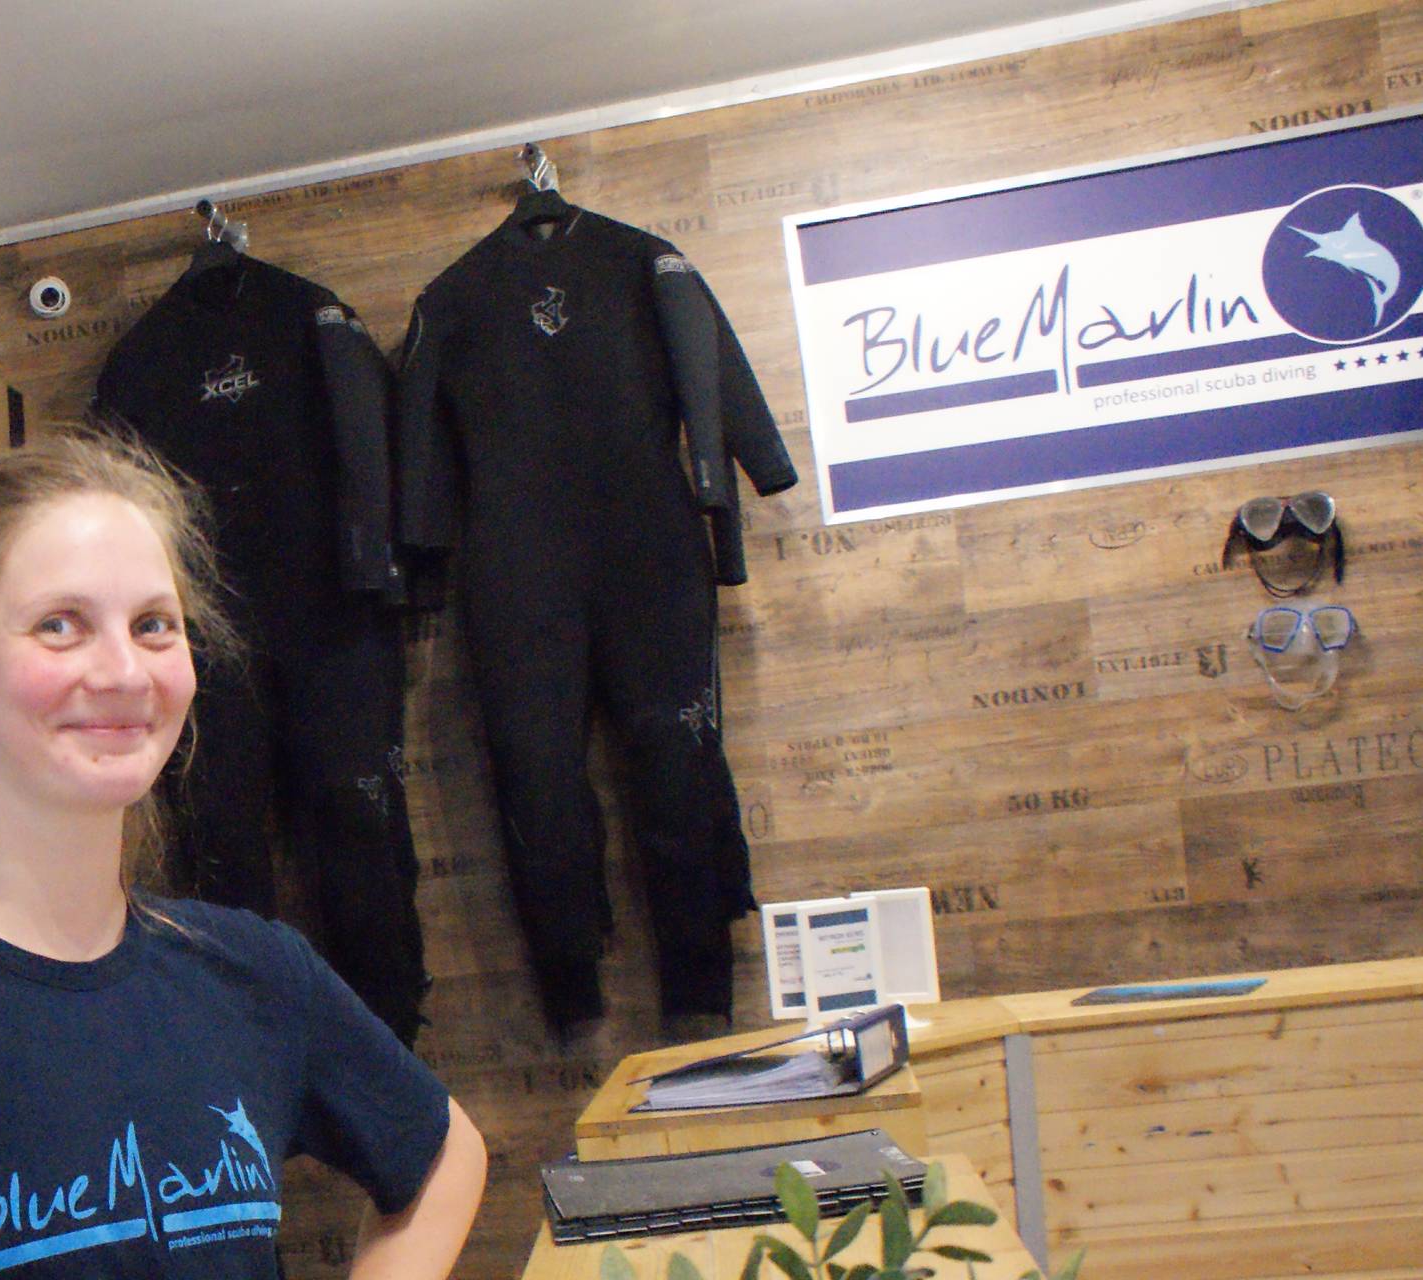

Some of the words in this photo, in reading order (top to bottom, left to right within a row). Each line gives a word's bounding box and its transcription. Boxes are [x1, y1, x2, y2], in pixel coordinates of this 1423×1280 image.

[201, 371, 260, 402] XCEL
[1093, 380, 1200, 412] professional
[1205, 367, 1258, 393] scuba
[1263, 362, 1318, 384] diving
[972, 681, 1088, 709] LONDON
[168, 1229, 225, 1250] professional
